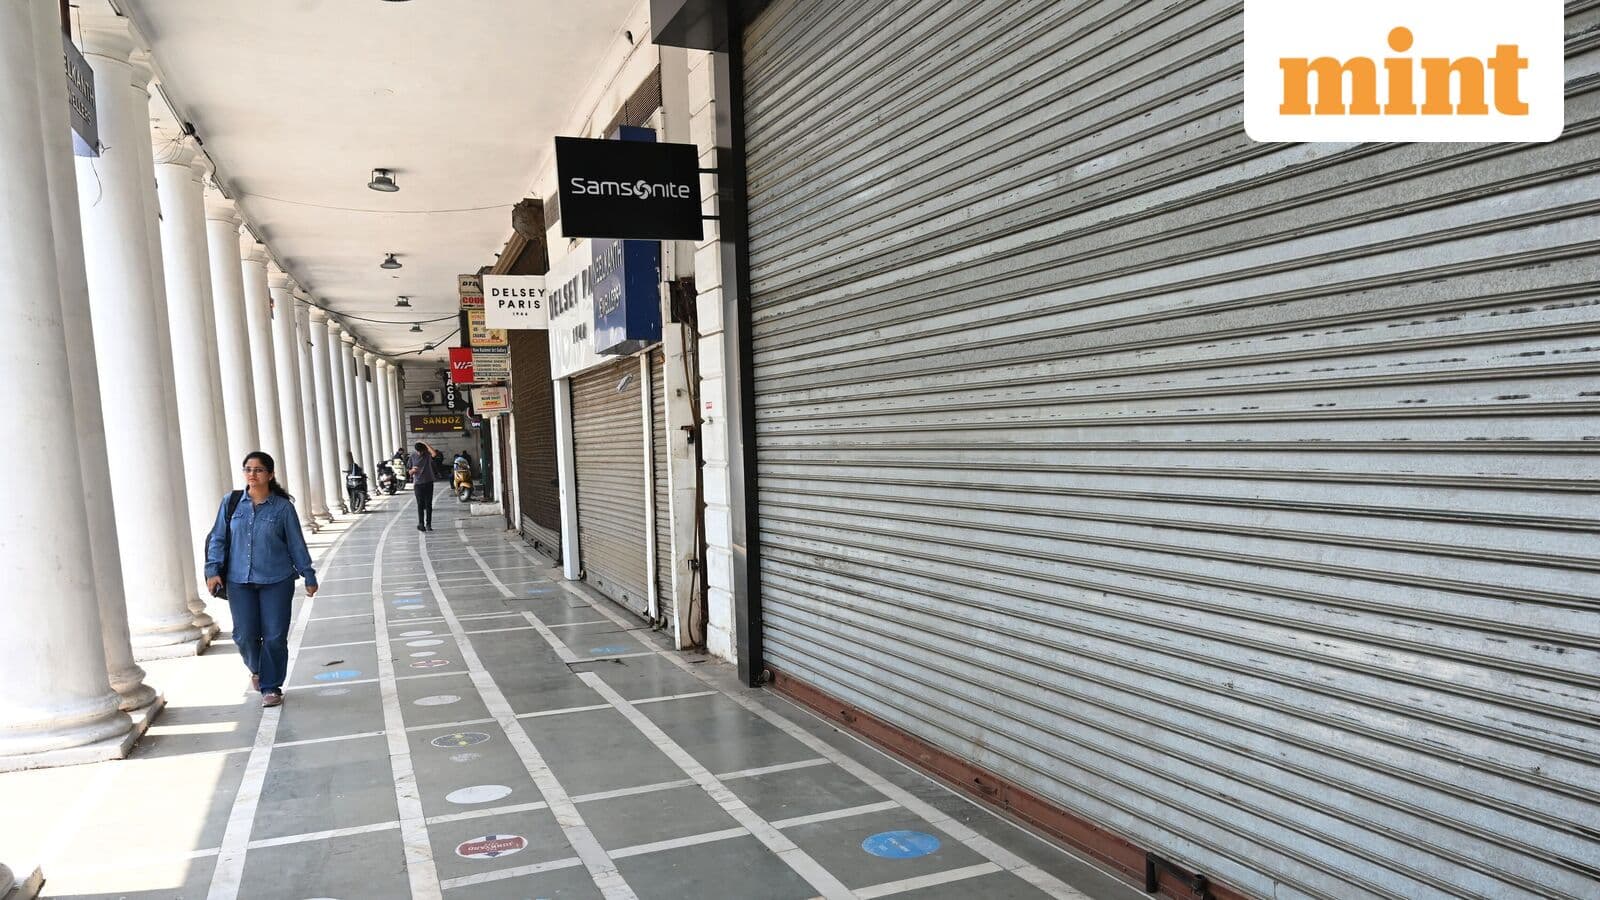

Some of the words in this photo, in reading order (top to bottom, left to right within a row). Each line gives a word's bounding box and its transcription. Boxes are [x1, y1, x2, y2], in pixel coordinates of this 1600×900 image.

[571, 177, 690, 199] Samsonite
[491, 288, 546, 297] DELSEY
[549, 273, 579, 320] DELSEY
[498, 299, 541, 309] PARIS
[453, 361, 474, 370] VIP
[446, 371, 455, 409] TACOS
[423, 416, 461, 425] SANDOZ
